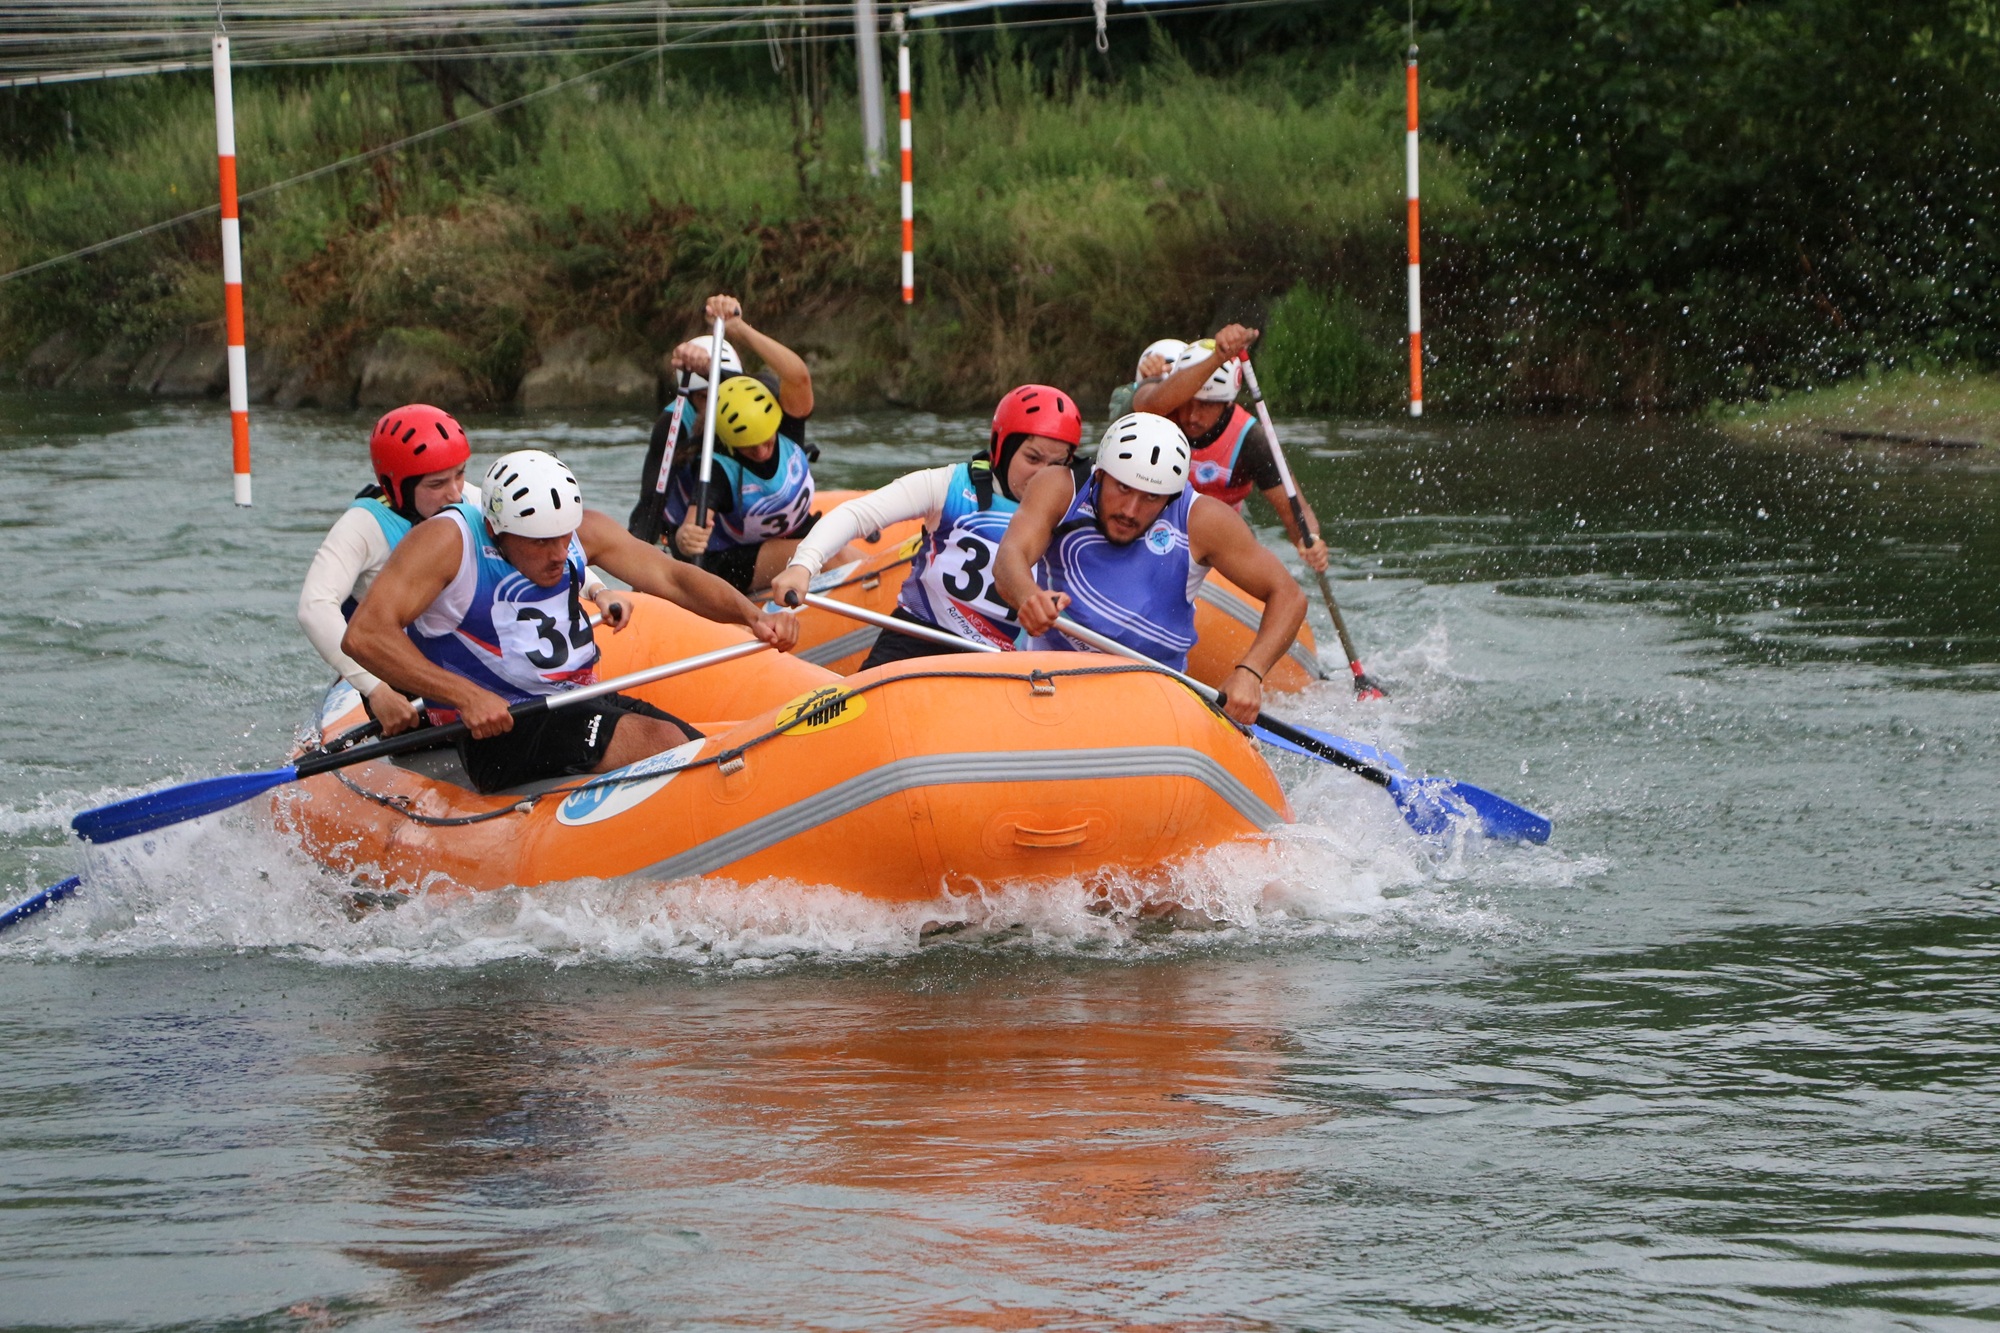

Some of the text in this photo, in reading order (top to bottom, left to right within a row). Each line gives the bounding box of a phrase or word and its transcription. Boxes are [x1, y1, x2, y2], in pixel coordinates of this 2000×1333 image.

[760, 486, 810, 538] 32
[516, 606, 594, 670] 34
[947, 606, 973, 635] Rafting
